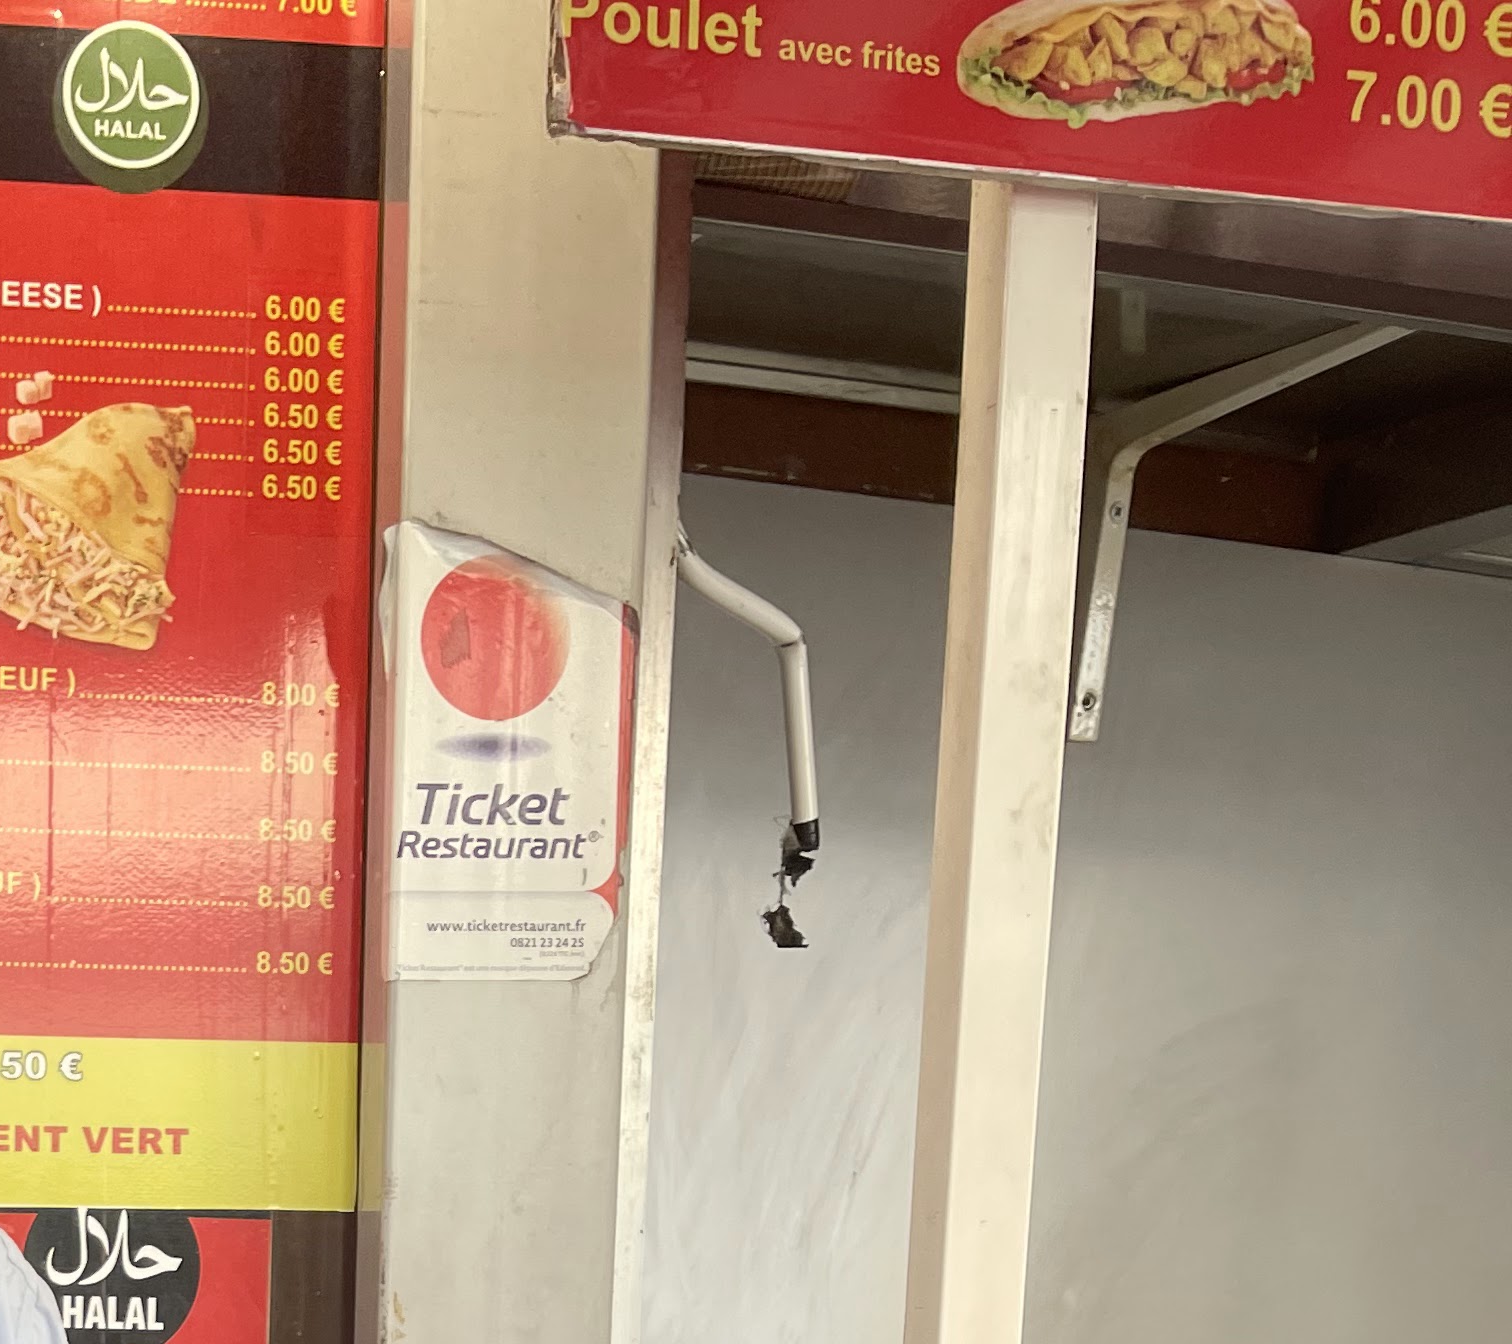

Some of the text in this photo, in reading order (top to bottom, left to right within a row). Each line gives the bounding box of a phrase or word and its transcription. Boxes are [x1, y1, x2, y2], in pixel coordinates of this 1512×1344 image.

[778, 39, 852, 67] avec
[860, 40, 941, 77] frites
[1350, 0, 1466, 52] 6.00
[1346, 69, 1462, 133] 7.00
[94, 119, 167, 142] HALAL
[265, 294, 321, 322] 6.00
[264, 330, 320, 357] 6.00
[264, 366, 320, 394] 6.00
[263, 402, 319, 429] 6.50
[263, 438, 318, 465] 6.50
[262, 473, 317, 500] 6.50
[261, 682, 317, 708] 8.00
[260, 752, 315, 776] 8.50
[416, 783, 572, 827] Ticket
[259, 818, 314, 843] 8.50
[257, 885, 312, 910] 8.50
[426, 918, 587, 933] www.ticketrestaurant.fr
[256, 951, 311, 977] 8.50
[81, 1126, 190, 1156] VERT
[63, 1294, 165, 1332] HALAL
